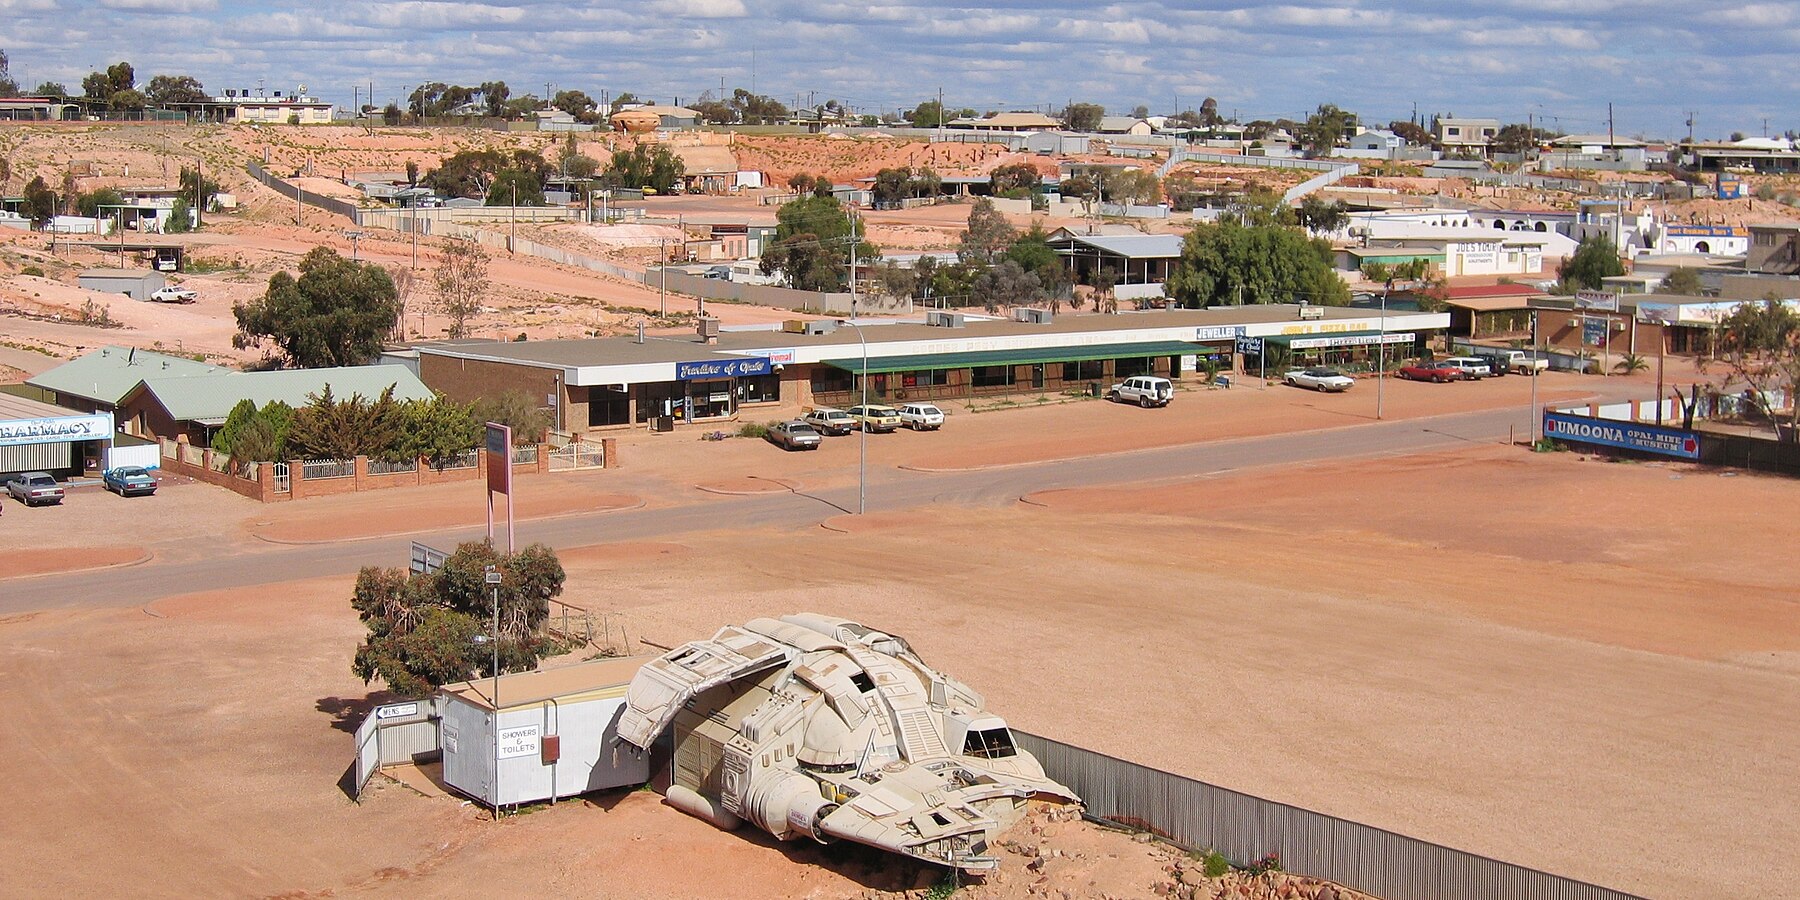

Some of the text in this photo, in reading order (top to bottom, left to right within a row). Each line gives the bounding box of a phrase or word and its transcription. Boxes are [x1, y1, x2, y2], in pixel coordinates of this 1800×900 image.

[0, 421, 96, 439] HARMACY
[1557, 421, 1682, 444] UMOONA OPAL MINE
[1635, 439, 1679, 451] MUSEUM
[383, 707, 400, 716] MENS
[502, 728, 537, 739] SHOWERS
[502, 743, 536, 754] TOILETS
